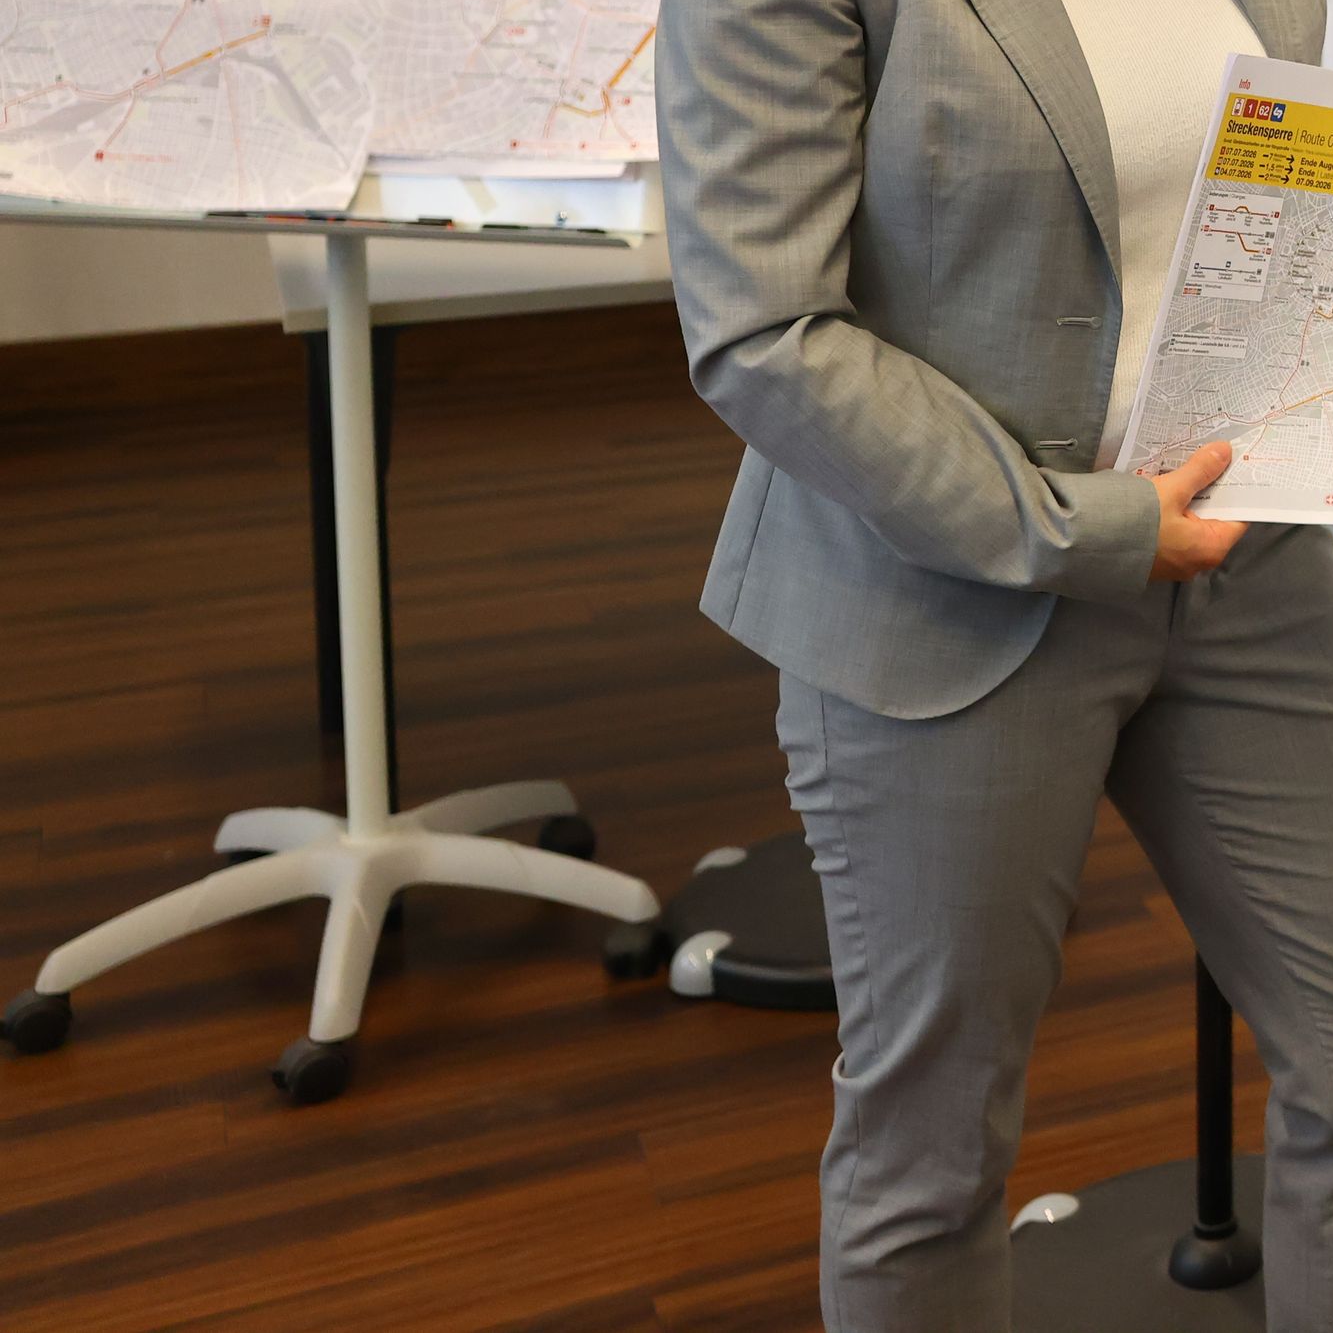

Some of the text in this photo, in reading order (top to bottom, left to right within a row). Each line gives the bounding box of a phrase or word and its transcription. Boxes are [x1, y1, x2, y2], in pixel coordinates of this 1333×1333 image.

[1248, 104, 1269, 116] 1 62
[1226, 119, 1293, 142] Streckensperre
[1299, 129, 1325, 147] Route
[1223, 157, 1255, 168] 07.07.2026
[1299, 168, 1315, 178] Ende
[1226, 148, 1257, 159] 07.07.2026
[1301, 158, 1317, 168] Ende
[1220, 167, 1252, 179] 04.07.2026
[1296, 178, 1331, 190] 07.09.2026
